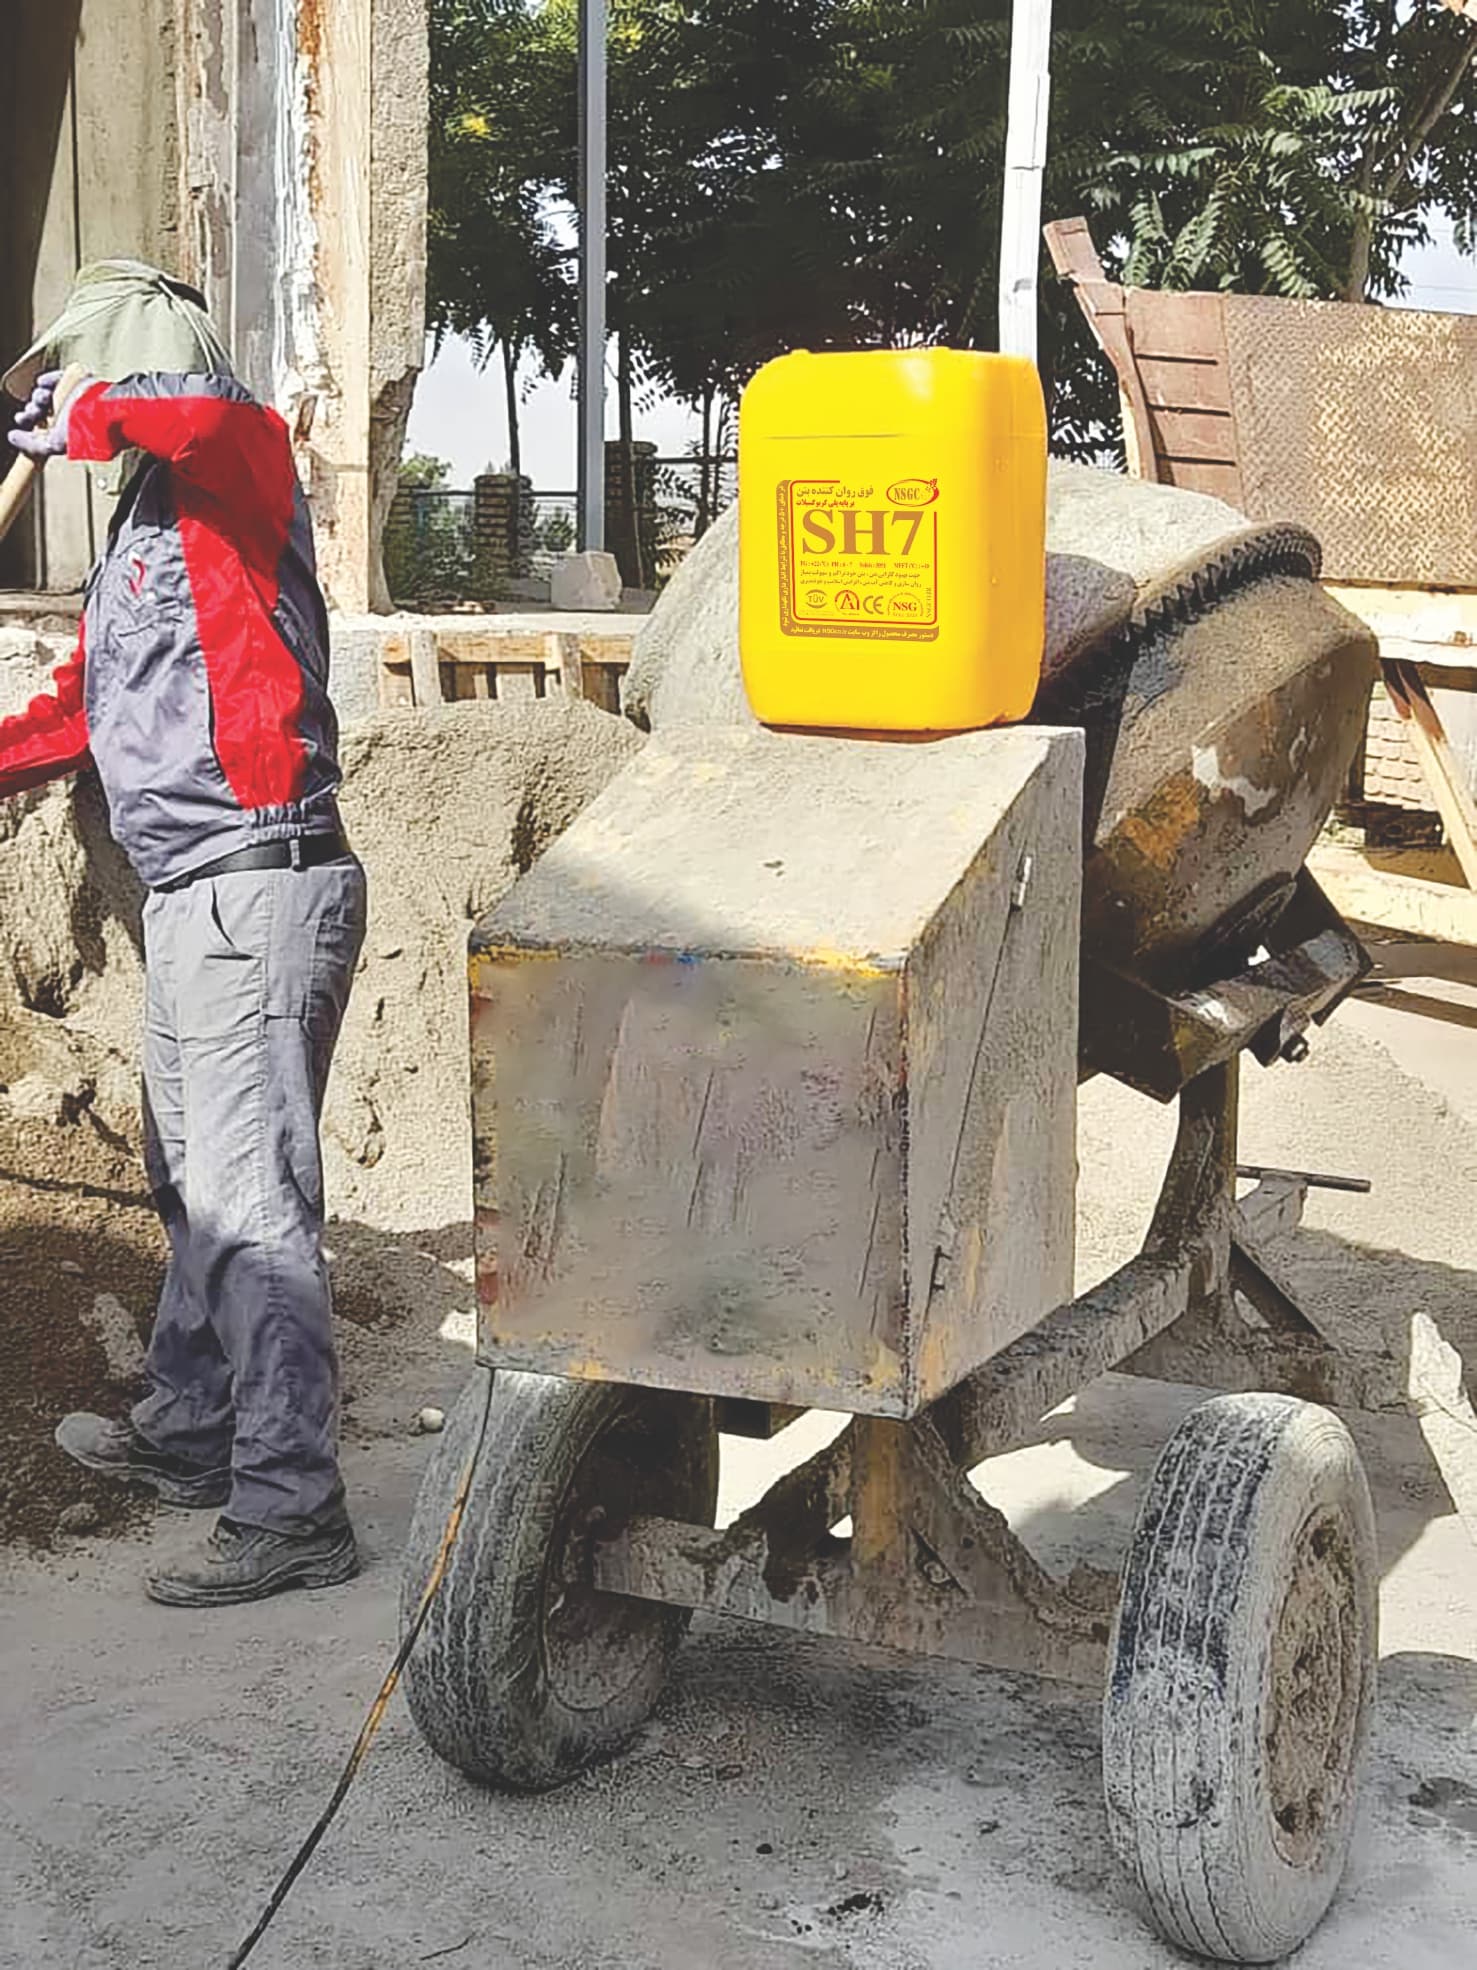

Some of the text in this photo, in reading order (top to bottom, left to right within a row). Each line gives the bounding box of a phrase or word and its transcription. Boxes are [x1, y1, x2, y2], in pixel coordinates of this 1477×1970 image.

[796, 485, 874, 498] فوق روان کننده بتن
[894, 487, 920, 501] NSGC
[802, 509, 924, 556] SH7
[808, 593, 824, 603] TÜV
[893, 601, 917, 612] NSG
